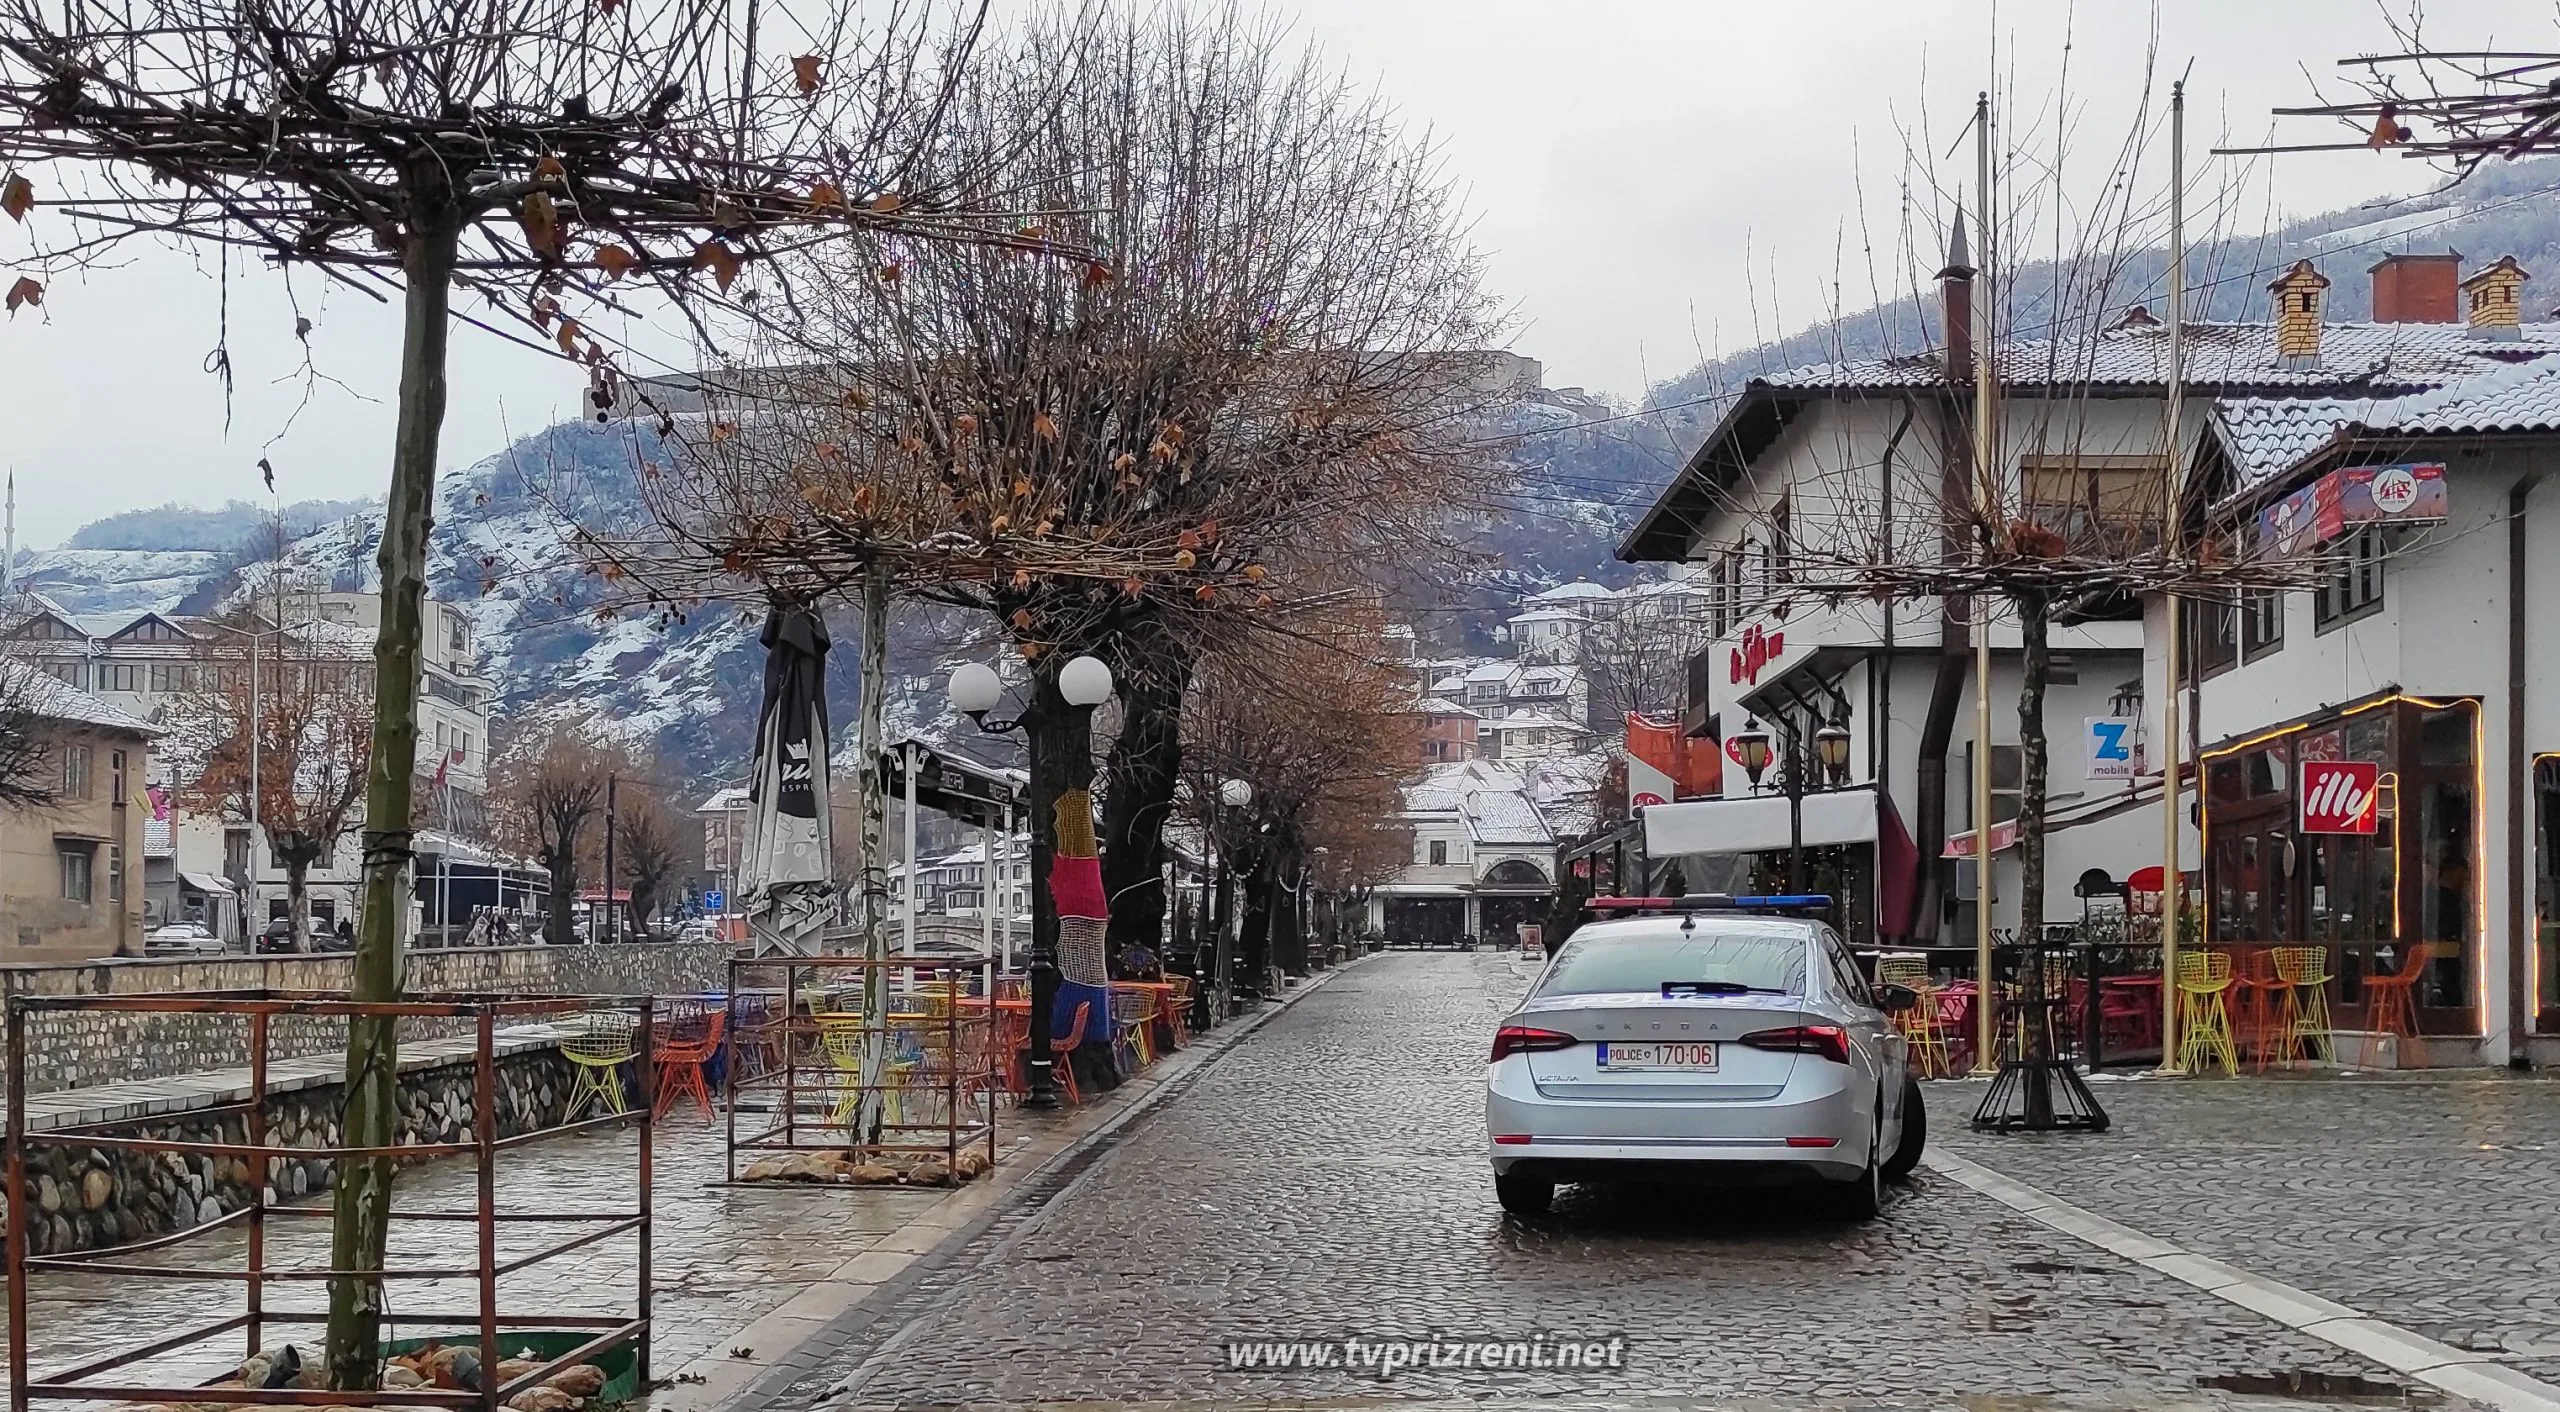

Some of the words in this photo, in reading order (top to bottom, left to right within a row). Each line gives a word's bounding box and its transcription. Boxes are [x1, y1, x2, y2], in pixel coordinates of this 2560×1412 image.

[2094, 765, 2130, 775] mobile
[2306, 771, 2374, 828] illy
[1609, 1048, 1643, 1061] POLICE
